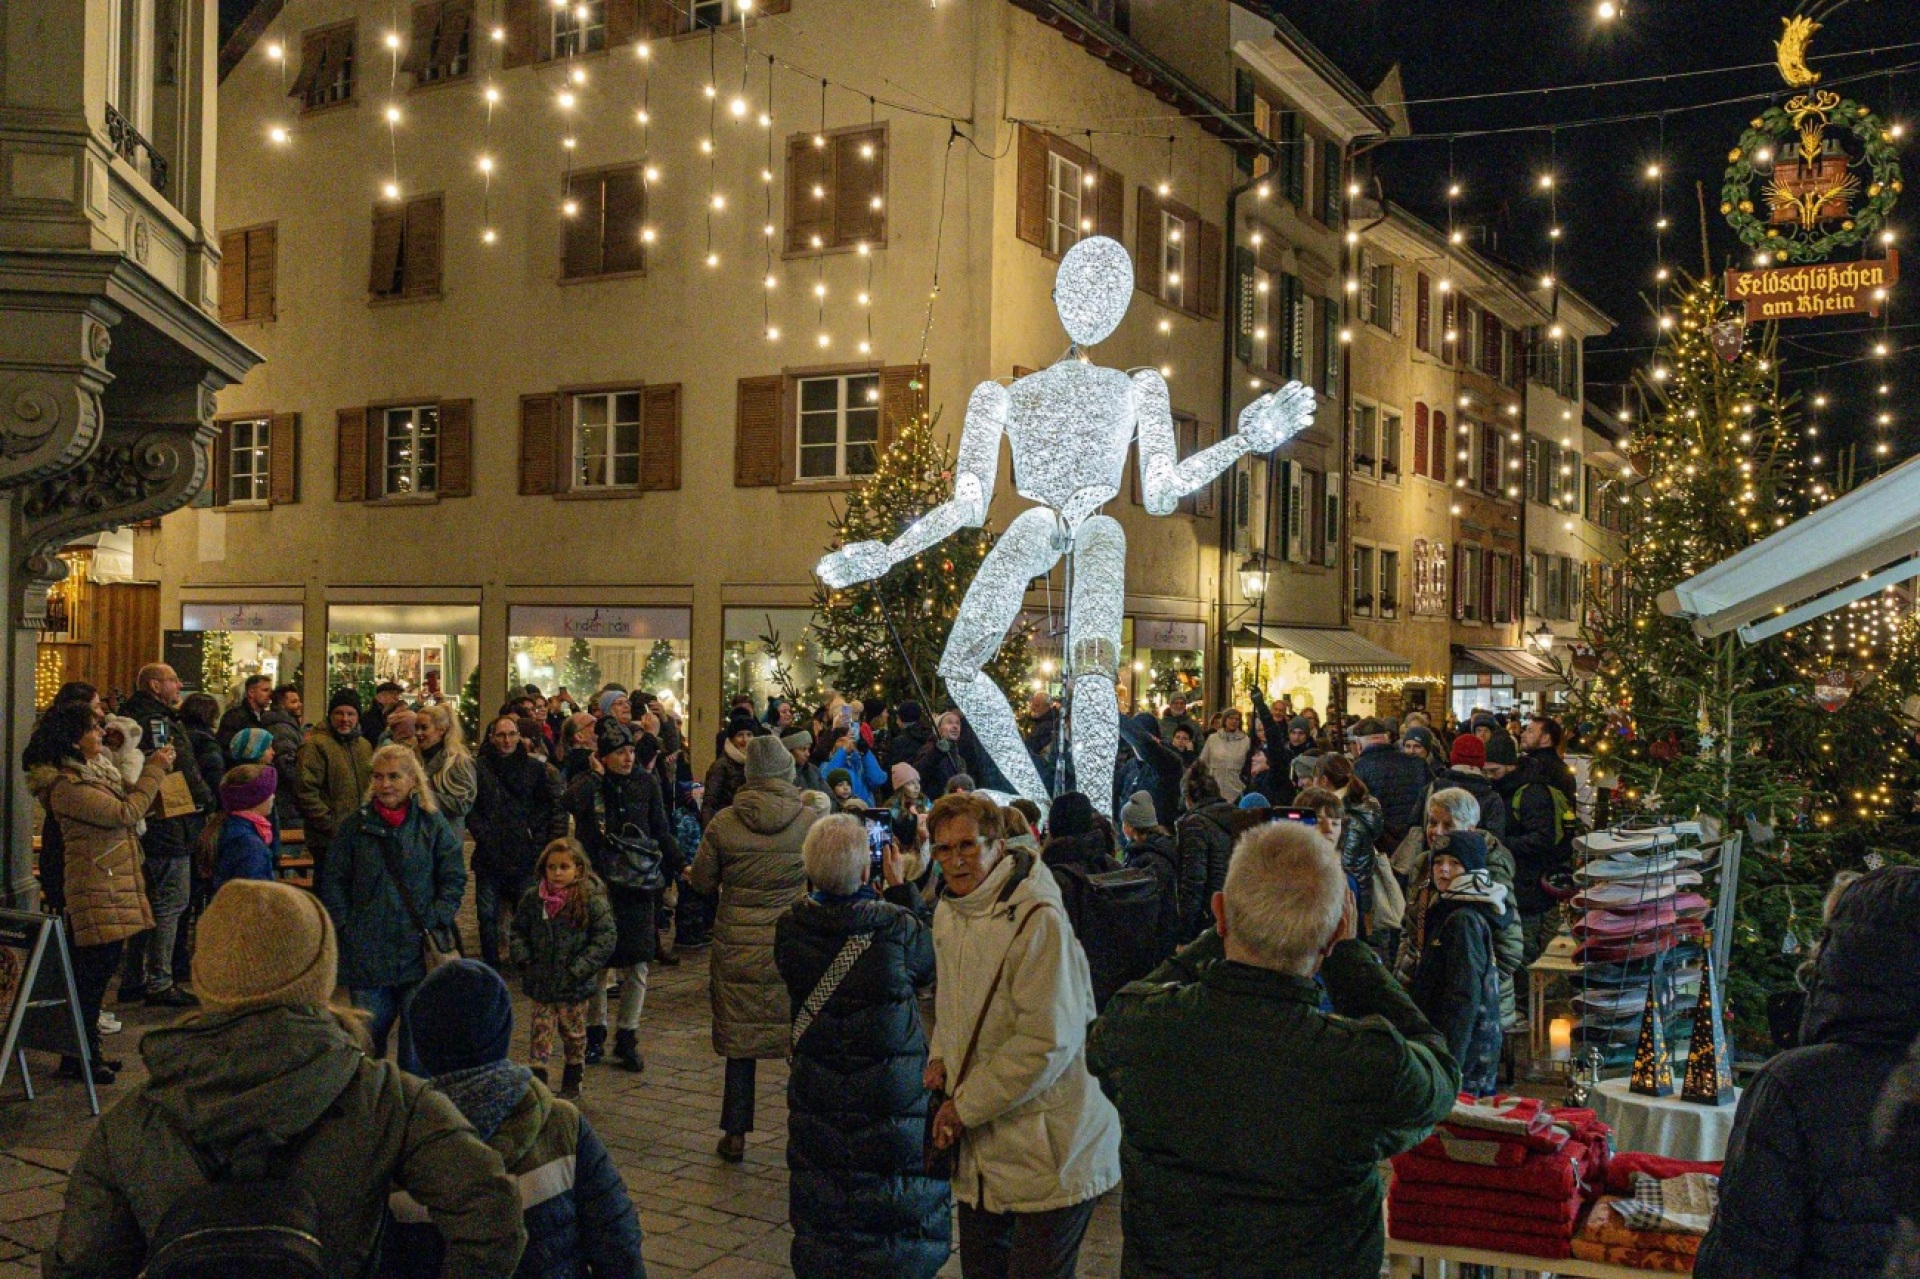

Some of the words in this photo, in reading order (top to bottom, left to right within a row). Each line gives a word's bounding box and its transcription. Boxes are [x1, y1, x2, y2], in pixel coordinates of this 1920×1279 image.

[1735, 264, 1884, 296] Feldschlößchen
[1762, 299, 1794, 316] am
[1796, 294, 1856, 315] Rhein
